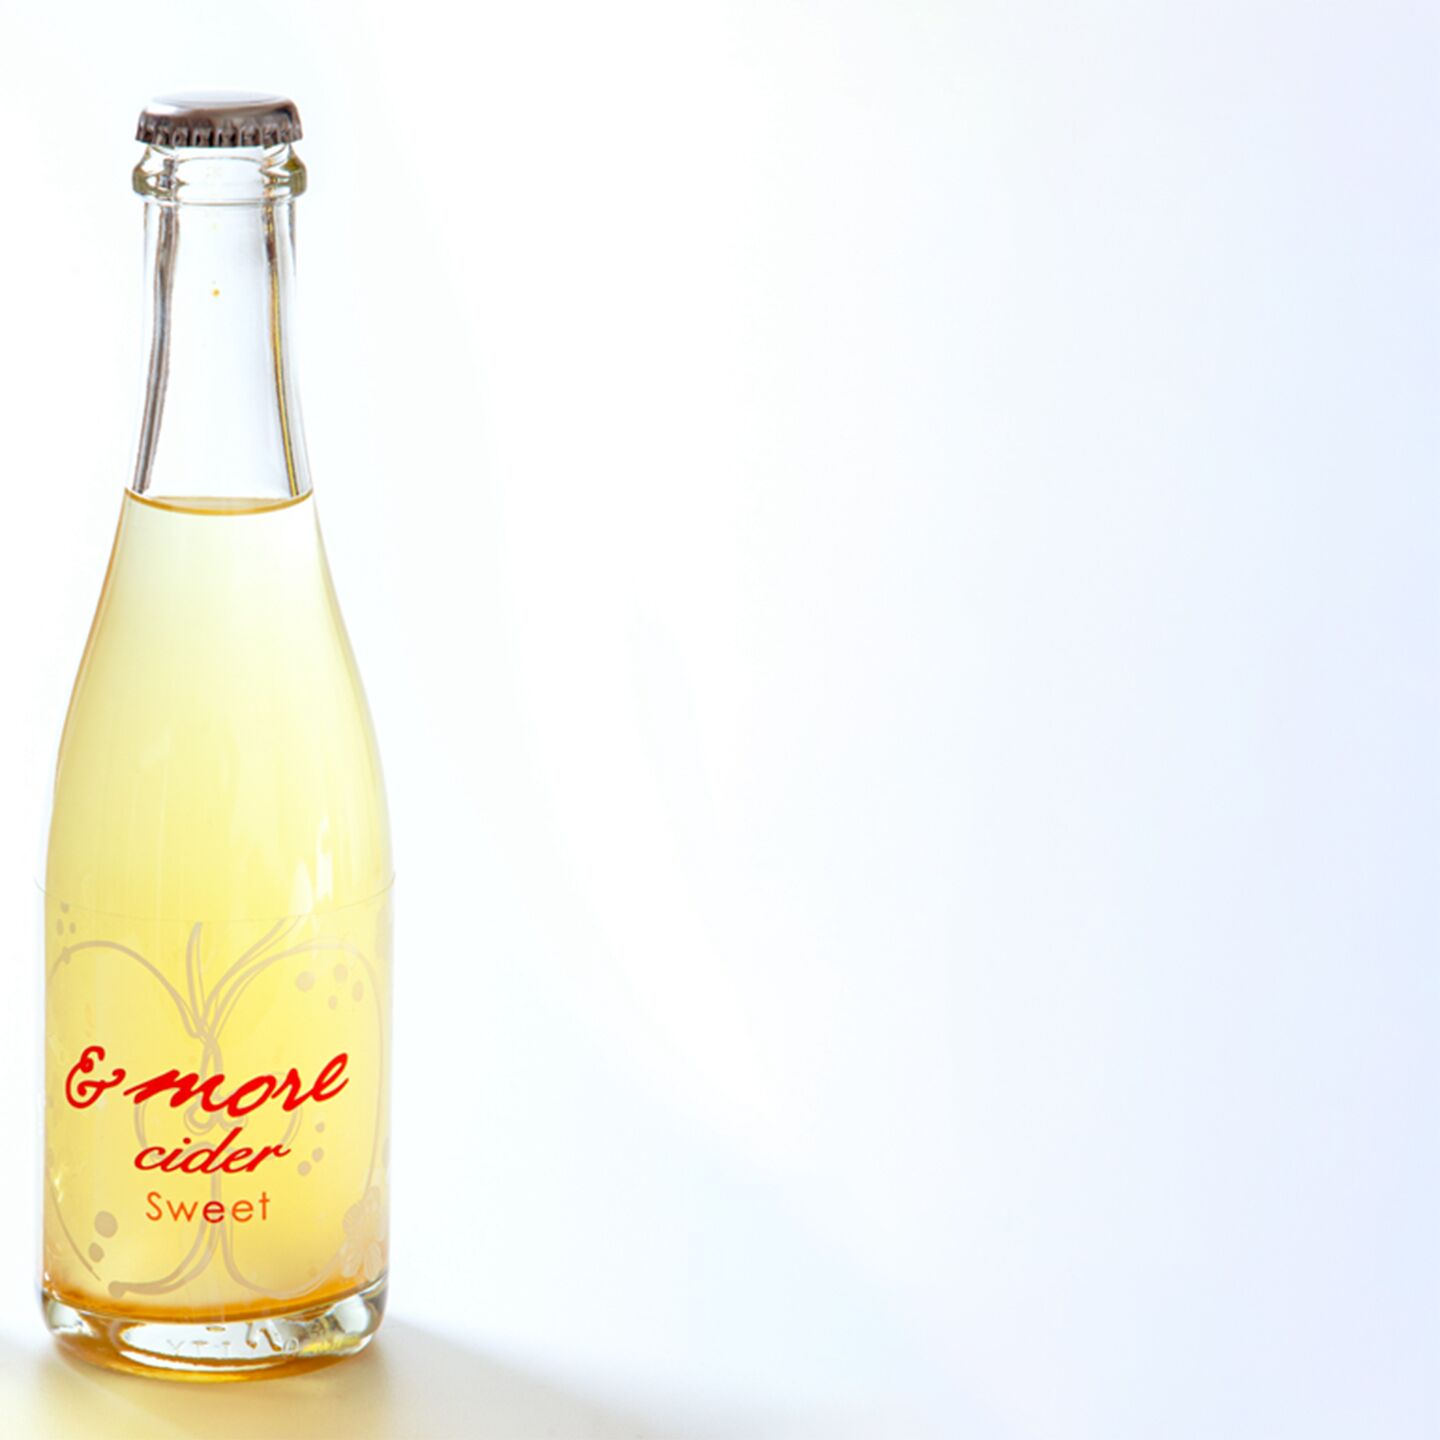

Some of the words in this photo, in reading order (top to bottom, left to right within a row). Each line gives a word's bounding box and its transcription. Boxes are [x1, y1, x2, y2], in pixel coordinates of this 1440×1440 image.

[64, 1044, 127, 1110] &
[122, 1052, 350, 1119] more
[133, 1125, 293, 1175] cider
[145, 1190, 271, 1225] Sweet
